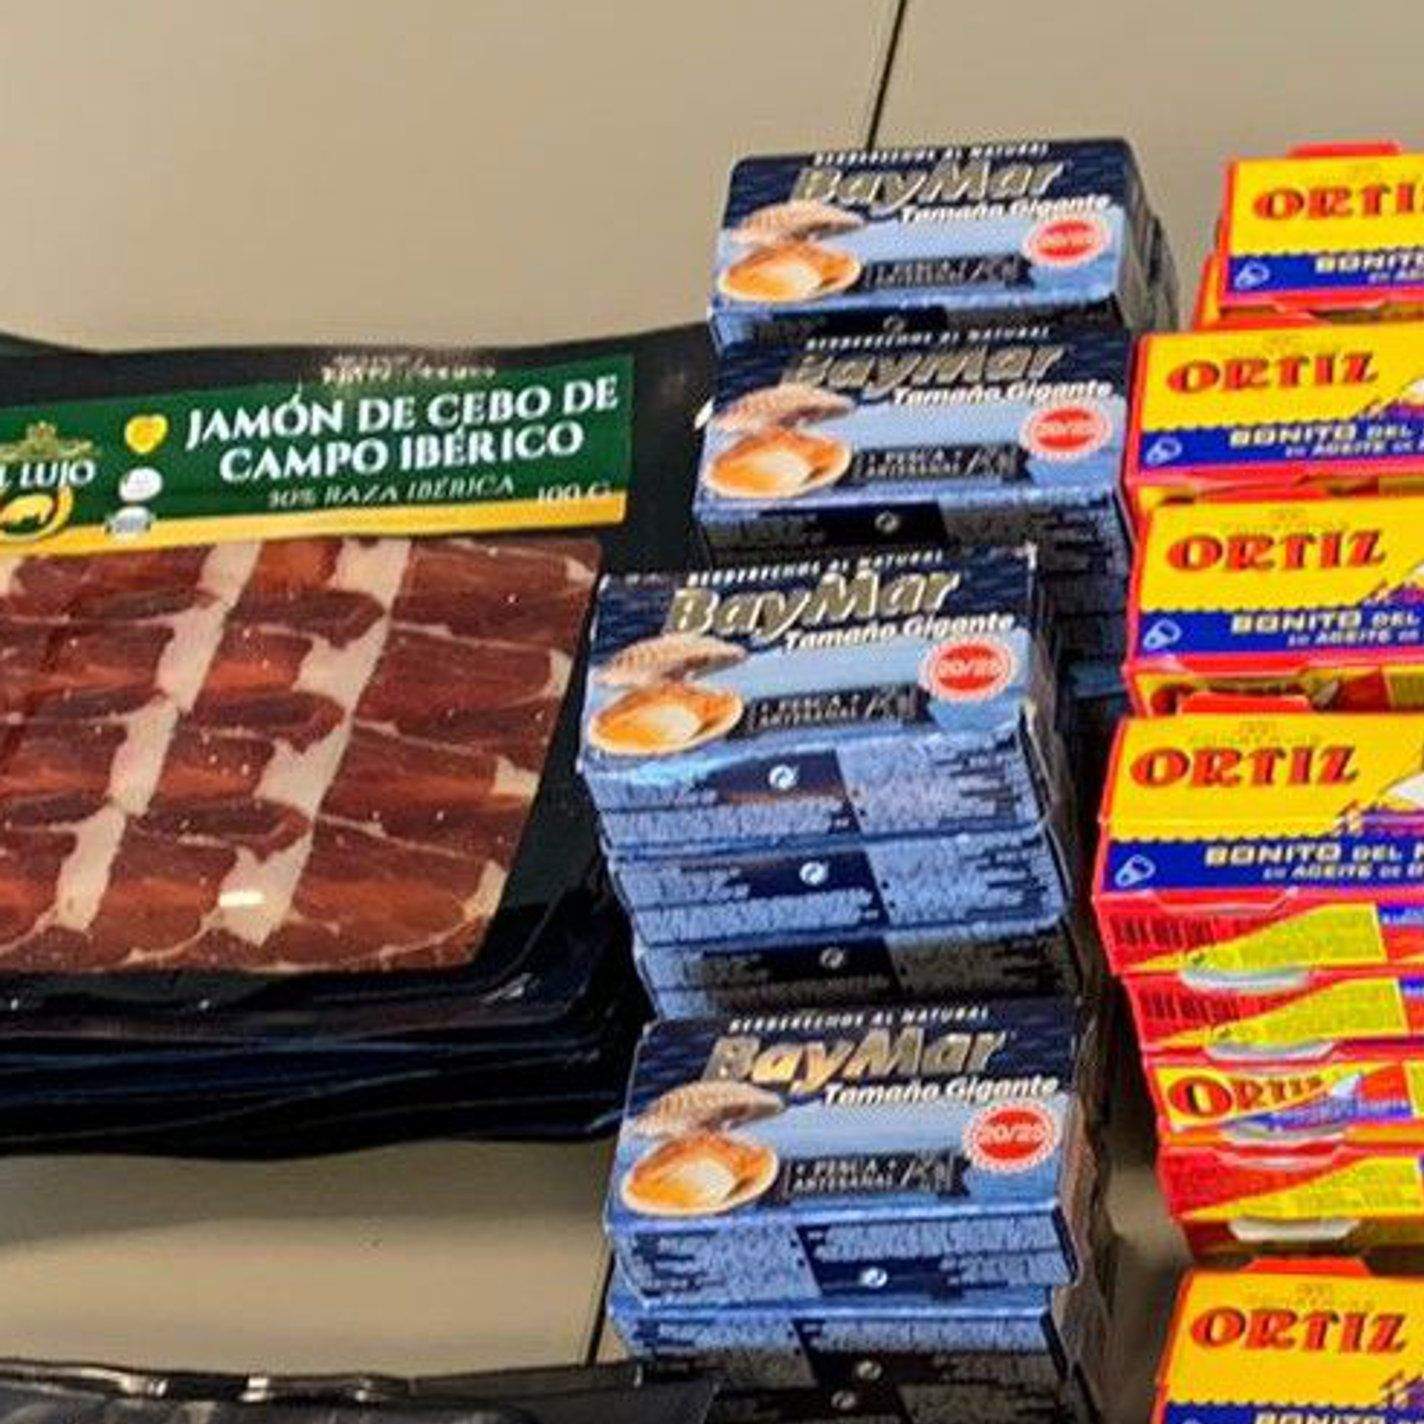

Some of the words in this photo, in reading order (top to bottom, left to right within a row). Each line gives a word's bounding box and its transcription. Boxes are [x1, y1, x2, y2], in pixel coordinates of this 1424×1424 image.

[796, 158, 1065, 213] BayMar
[1167, 353, 1379, 394] ORTIZ
[186, 394, 353, 450] JAMÓN
[358, 398, 416, 431] DE
[426, 385, 551, 427] CEBO
[563, 377, 619, 409] DE
[220, 443, 385, 483] CAMPO
[399, 421, 584, 468] IBÉRICO
[1230, 426, 1354, 447] BONITO
[1368, 424, 1411, 437] DEL
[1312, 440, 1386, 457] ACEITE
[20, 460, 96, 489] LUJO
[324, 482, 398, 503] RAZA
[1167, 531, 1387, 572] ORTIZ
[666, 572, 960, 639] BayMar
[1232, 613, 1362, 633] BONITO
[1373, 612, 1419, 626] DEL
[785, 626, 896, 653] Tamaño
[903, 613, 1015, 637] Gigante
[1316, 627, 1392, 644] ACEITE
[1131, 745, 1358, 789] ORTIZ
[1206, 844, 1342, 867] BONITO
[1354, 844, 1403, 861] DEL
[1297, 863, 1371, 879] ACEITE
[705, 1028, 1006, 1091] BayMar
[824, 1081, 940, 1105] Tamaño
[947, 1075, 1058, 1097] Gigante
[1192, 1309, 1406, 1356] ORTIZ
